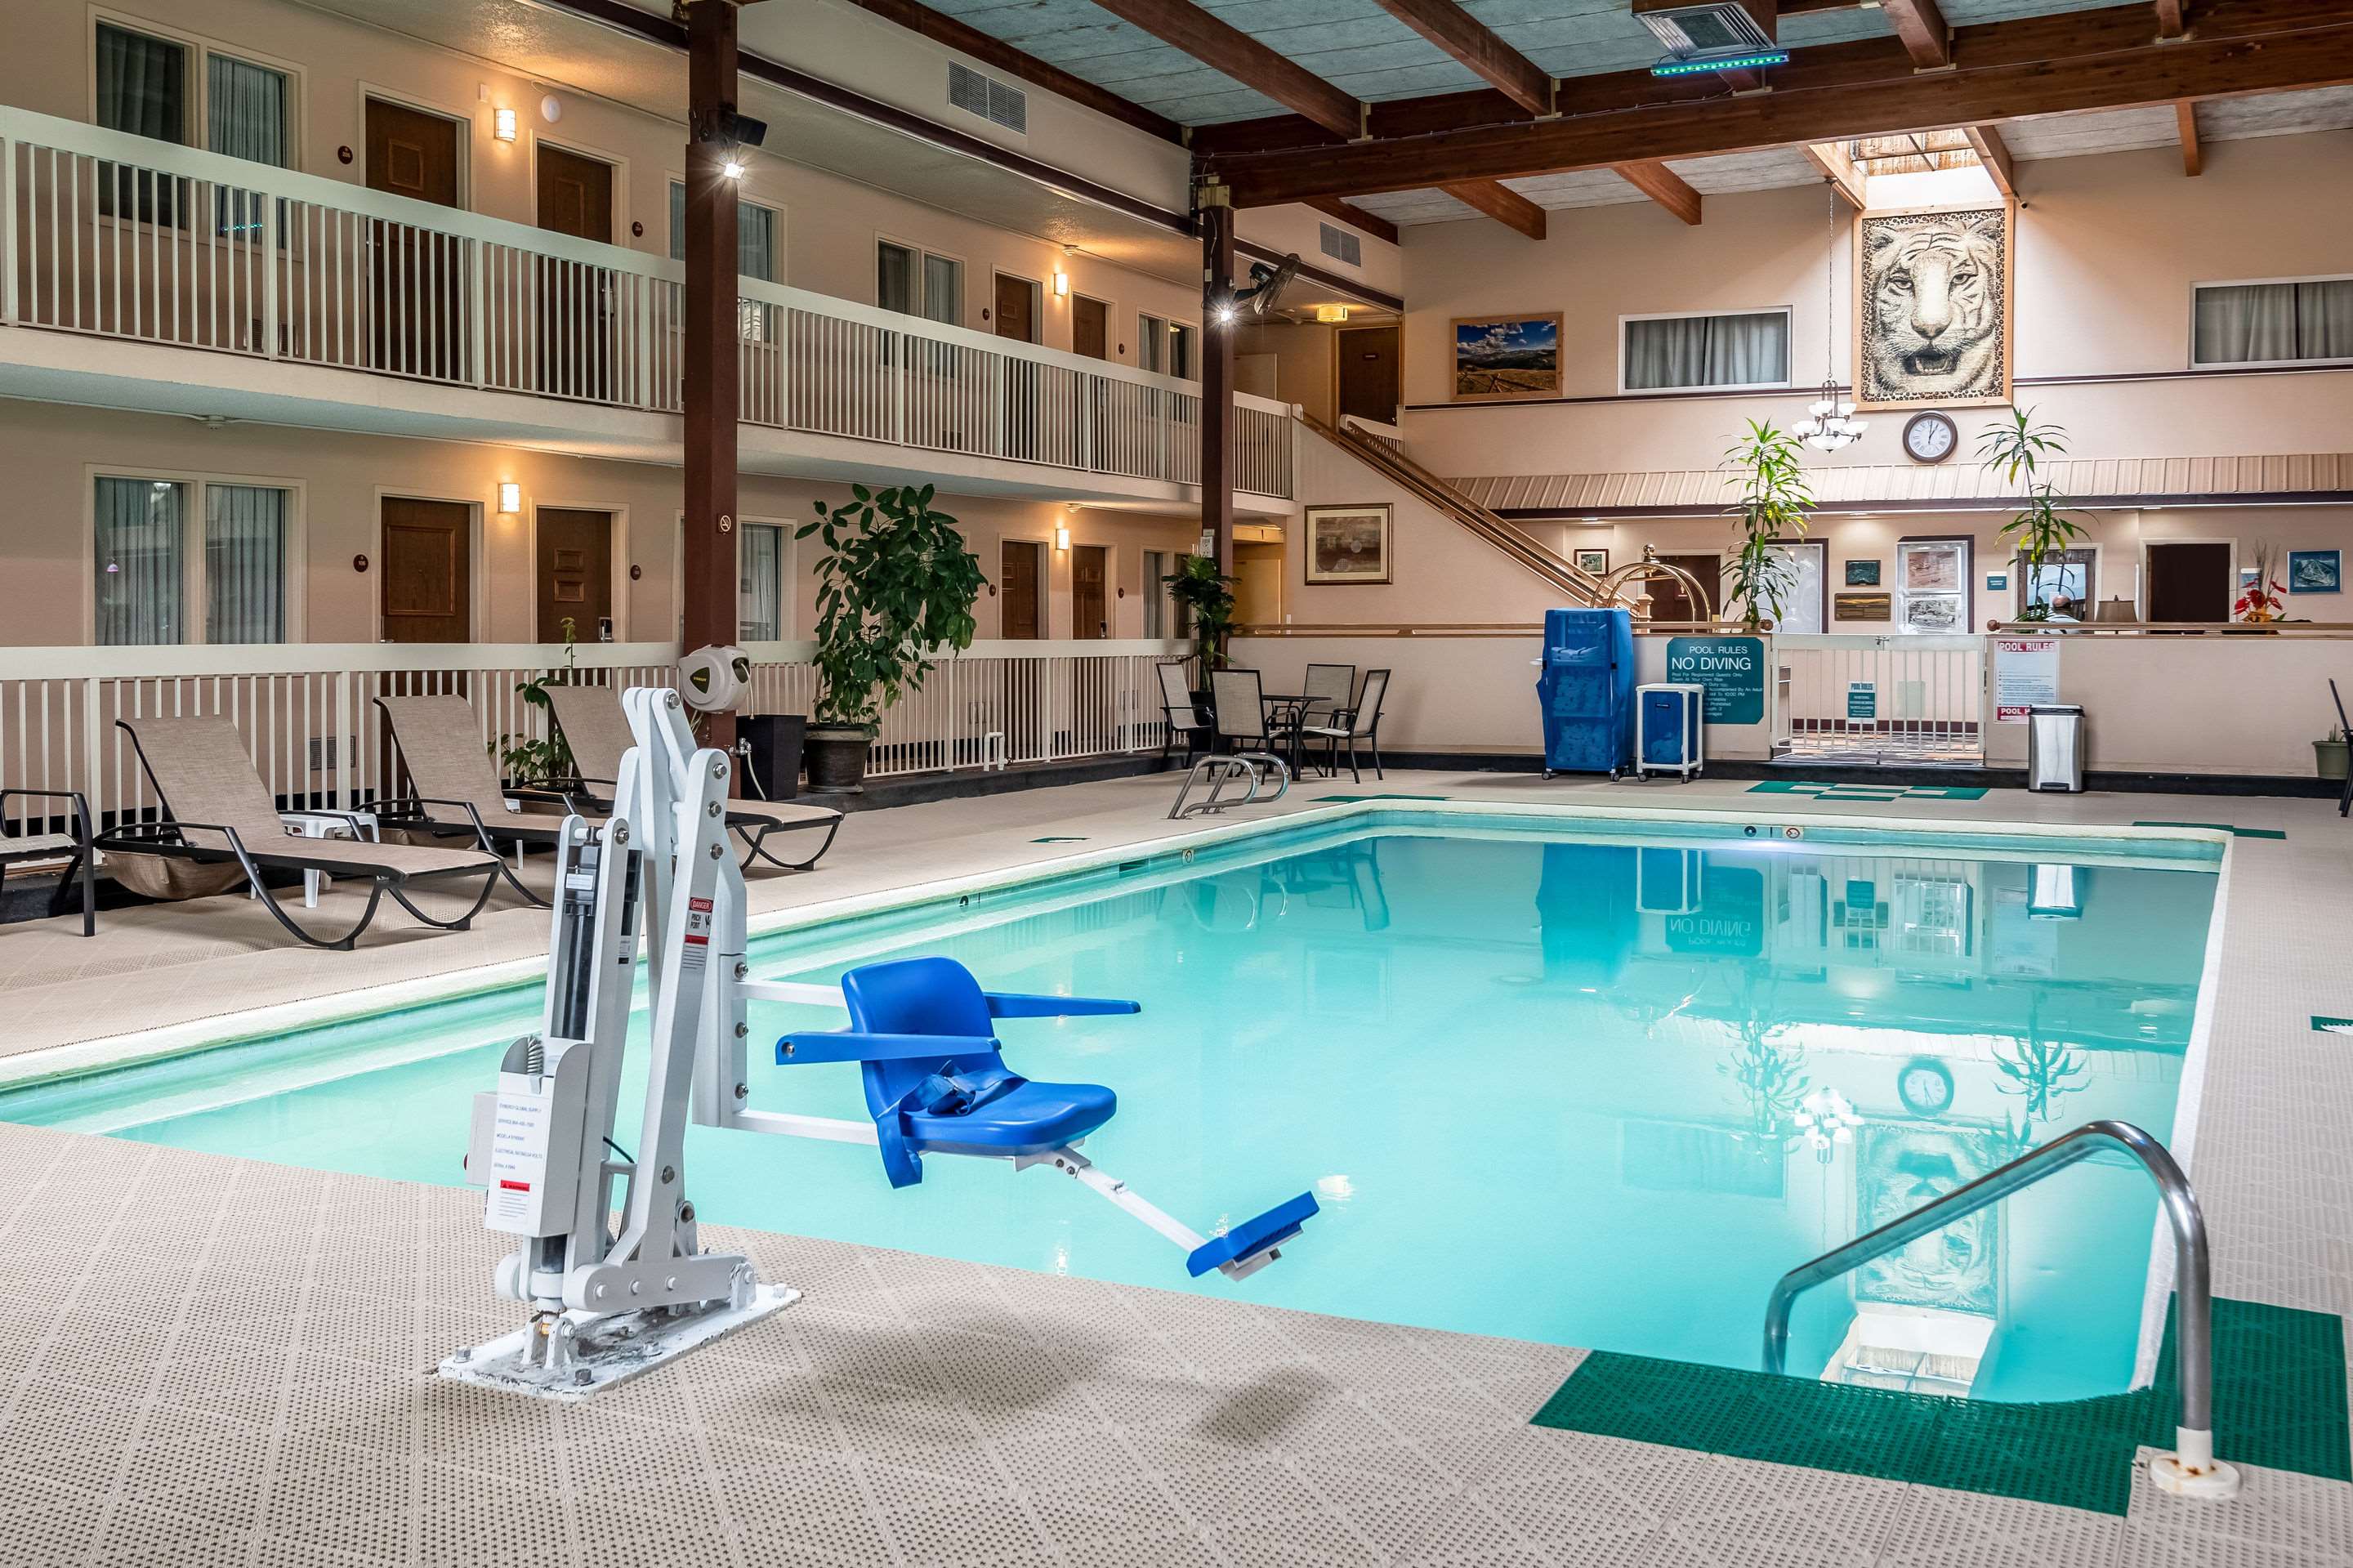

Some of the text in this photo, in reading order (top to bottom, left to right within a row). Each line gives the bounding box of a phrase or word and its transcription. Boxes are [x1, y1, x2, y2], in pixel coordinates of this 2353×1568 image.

[1999, 642, 2055, 651] POOL RULES
[1672, 657, 1752, 670] NO DIVING
[692, 900, 709, 909] DANGER
